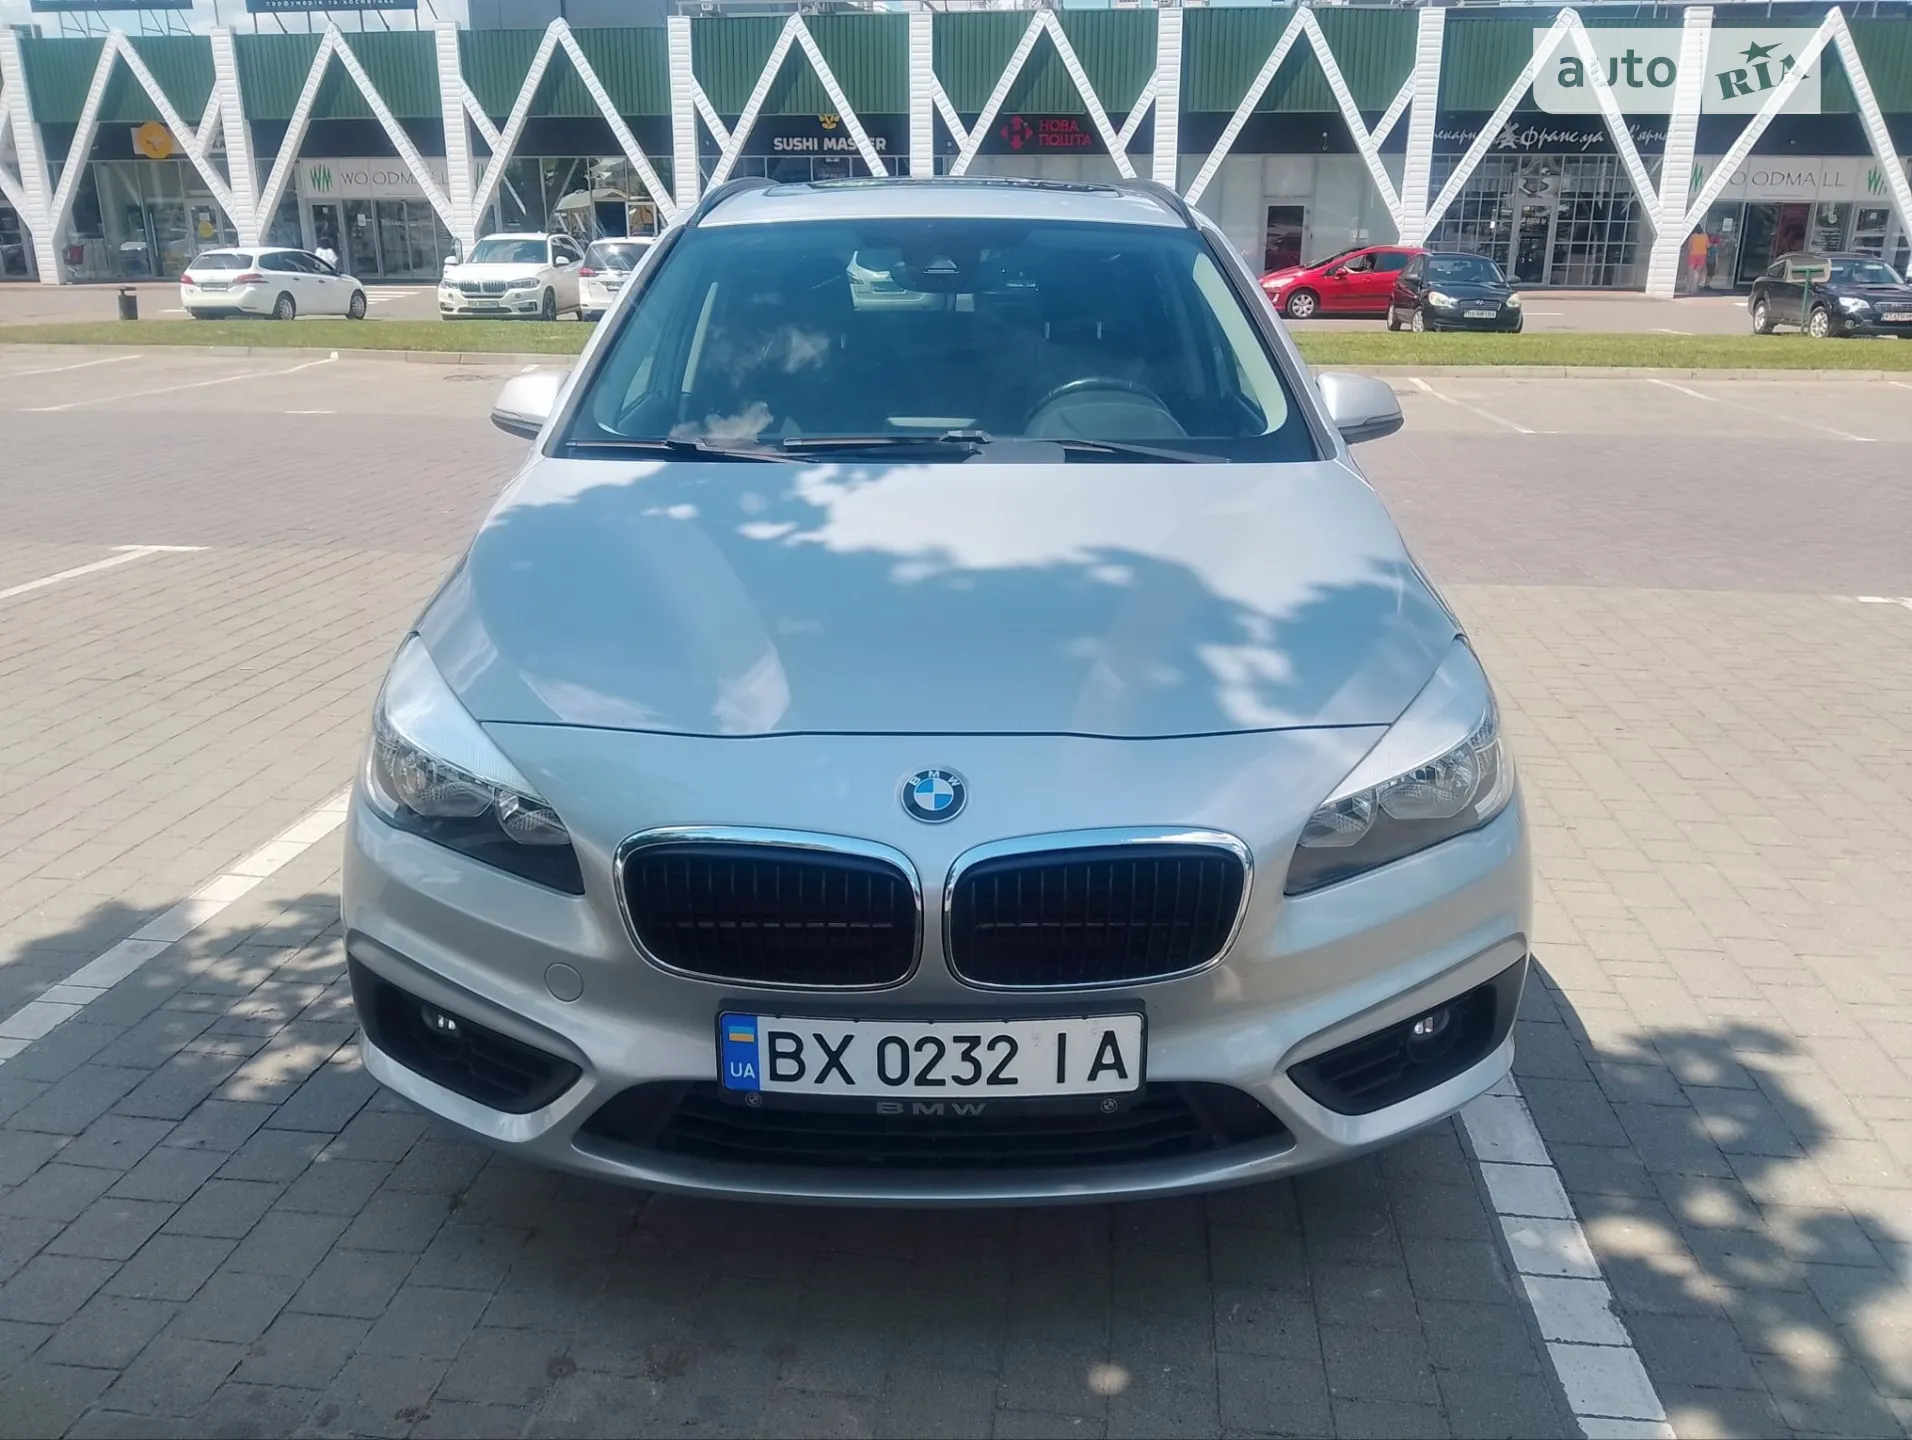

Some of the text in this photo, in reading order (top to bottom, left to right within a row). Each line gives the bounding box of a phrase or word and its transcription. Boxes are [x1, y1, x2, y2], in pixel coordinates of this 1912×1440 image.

[1039, 119, 1080, 133] НОВА
[773, 136, 887, 151] SUSHI MASER
[1038, 133, 1093, 146] ПОШТА
[1728, 171, 1846, 187] OODMALL
[908, 769, 961, 787] BMW
[729, 1029, 1130, 1087] UA BX 0232 IA
[876, 1101, 987, 1116] BMW
